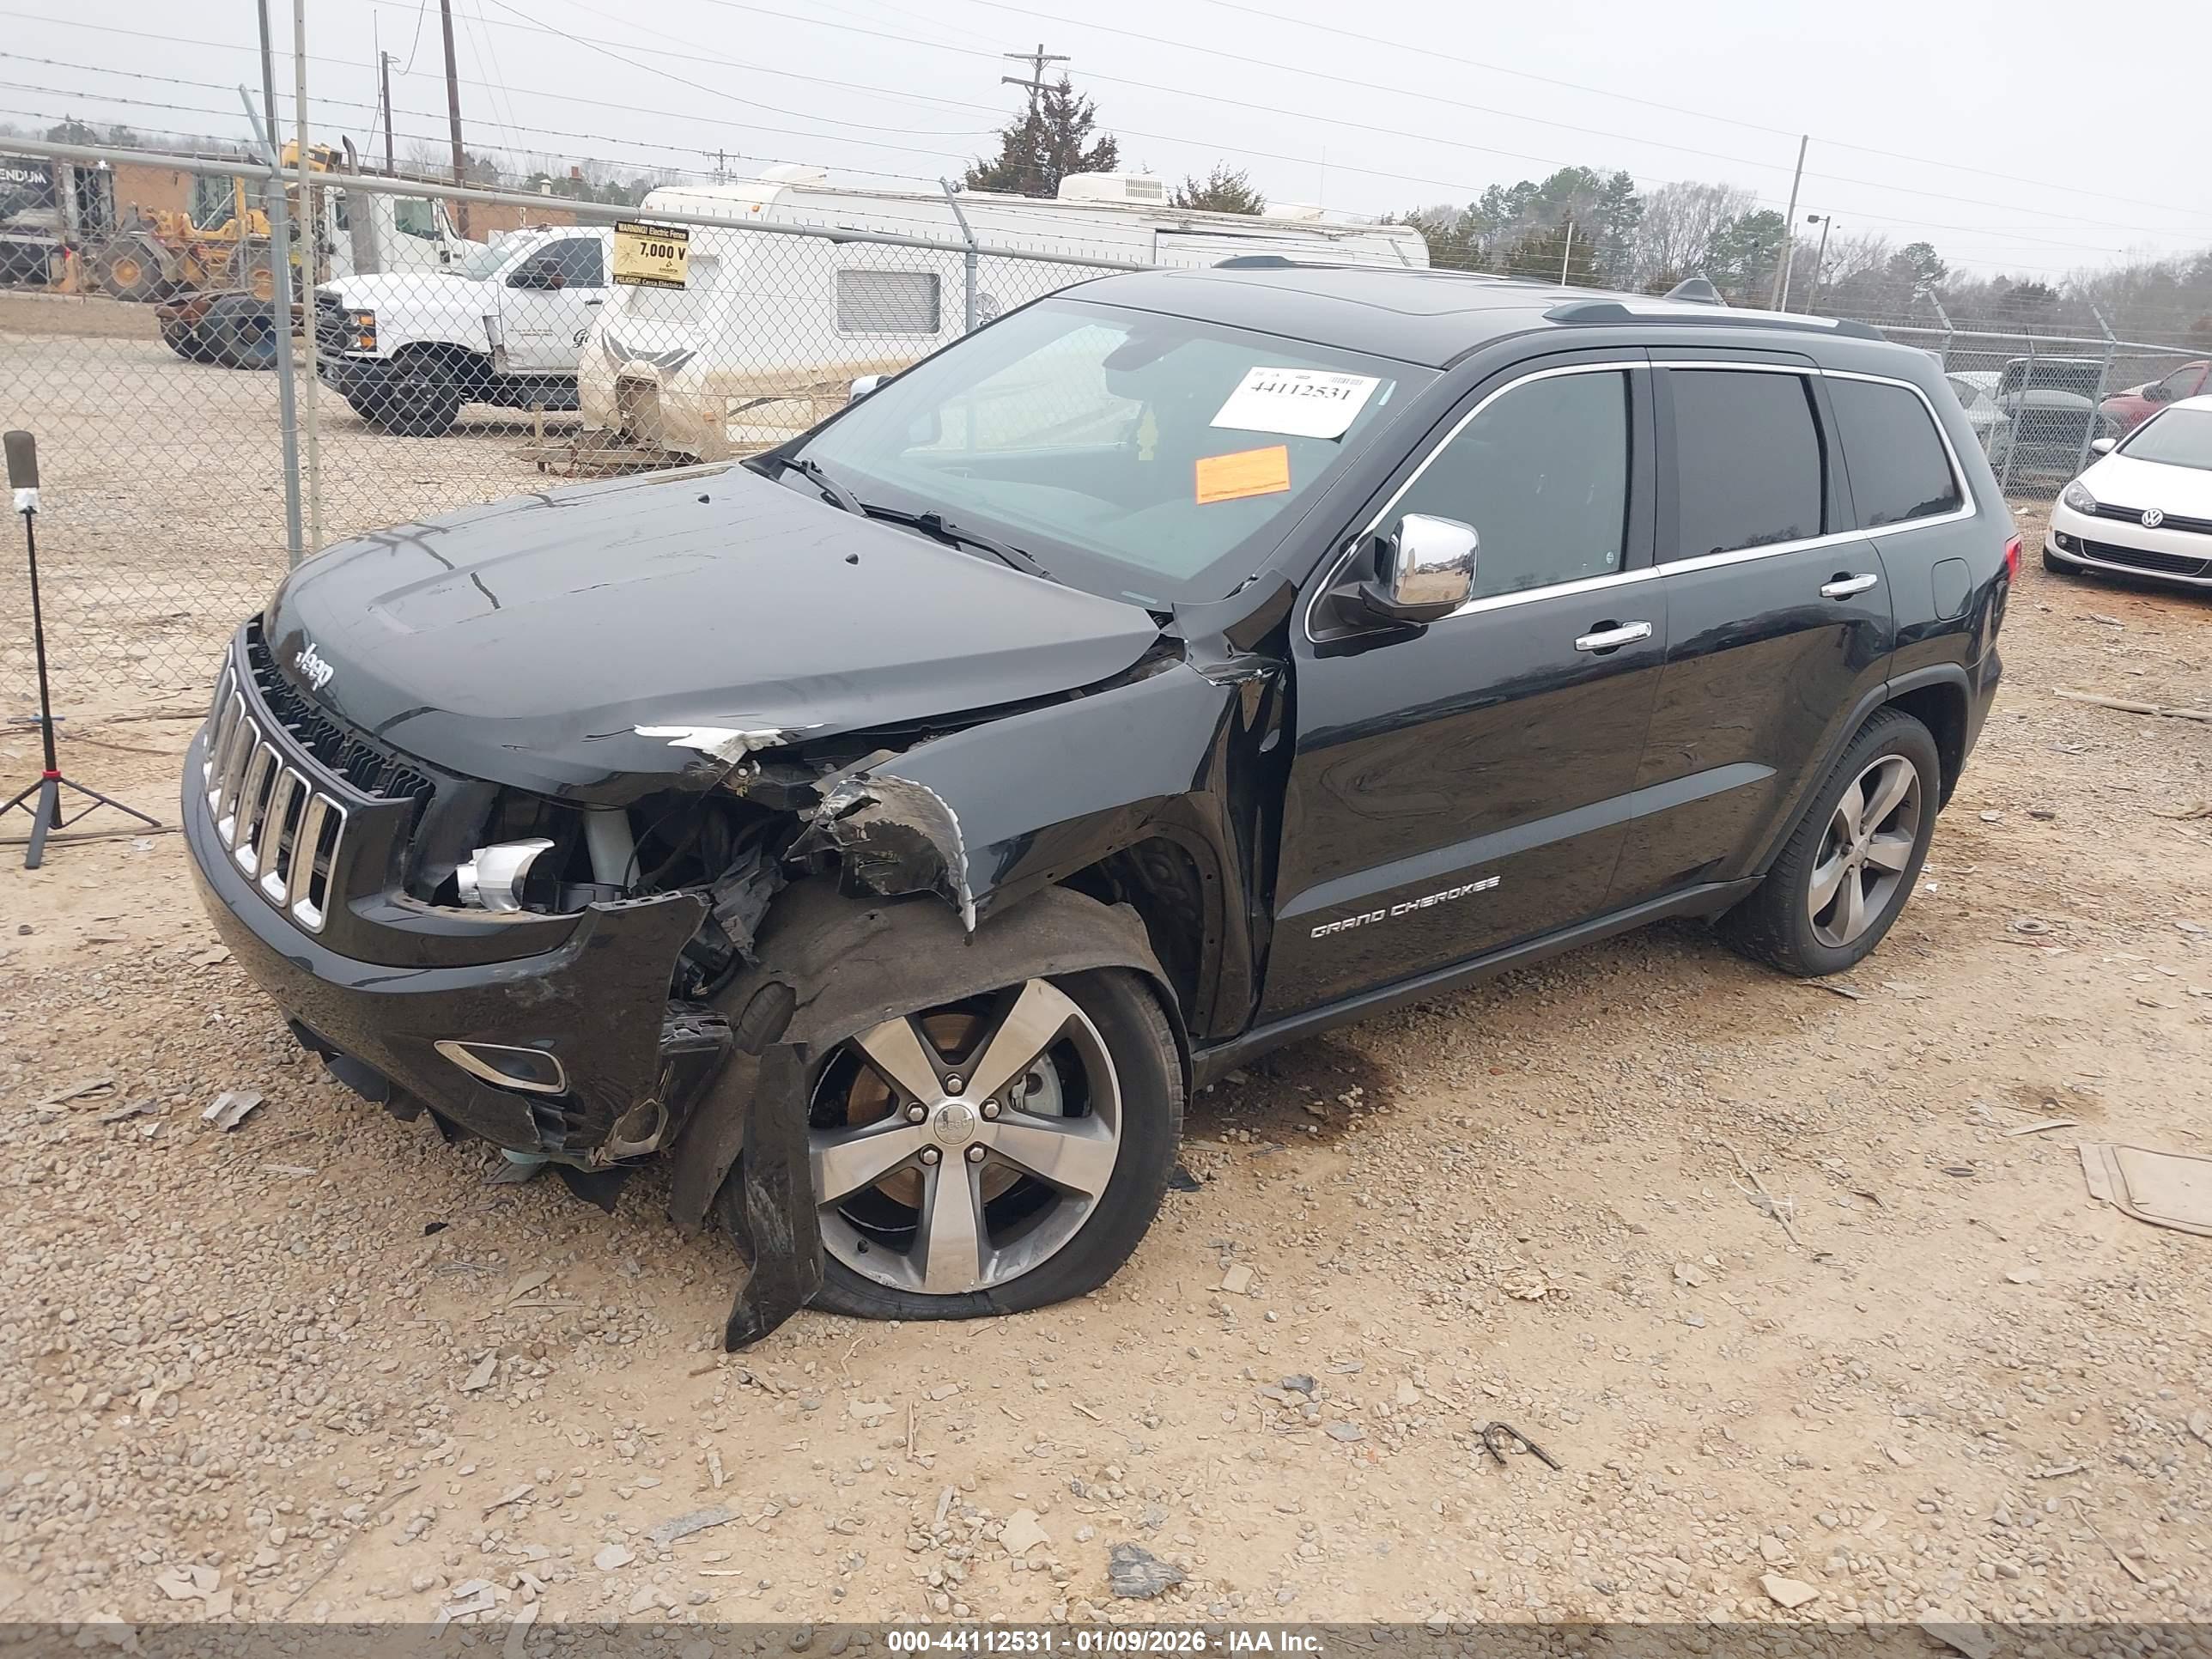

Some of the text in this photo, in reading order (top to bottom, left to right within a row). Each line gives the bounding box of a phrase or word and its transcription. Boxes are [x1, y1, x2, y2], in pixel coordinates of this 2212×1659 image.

[618, 222, 648, 235] WARNING!
[648, 228, 669, 237] Electric
[670, 230, 687, 240] Fence
[640, 242, 686, 260] 7,000 V
[1251, 381, 1351, 400] 44112531
[294, 642, 334, 691] Jeep
[1310, 875, 1501, 939] GRAND CHEROKEE
